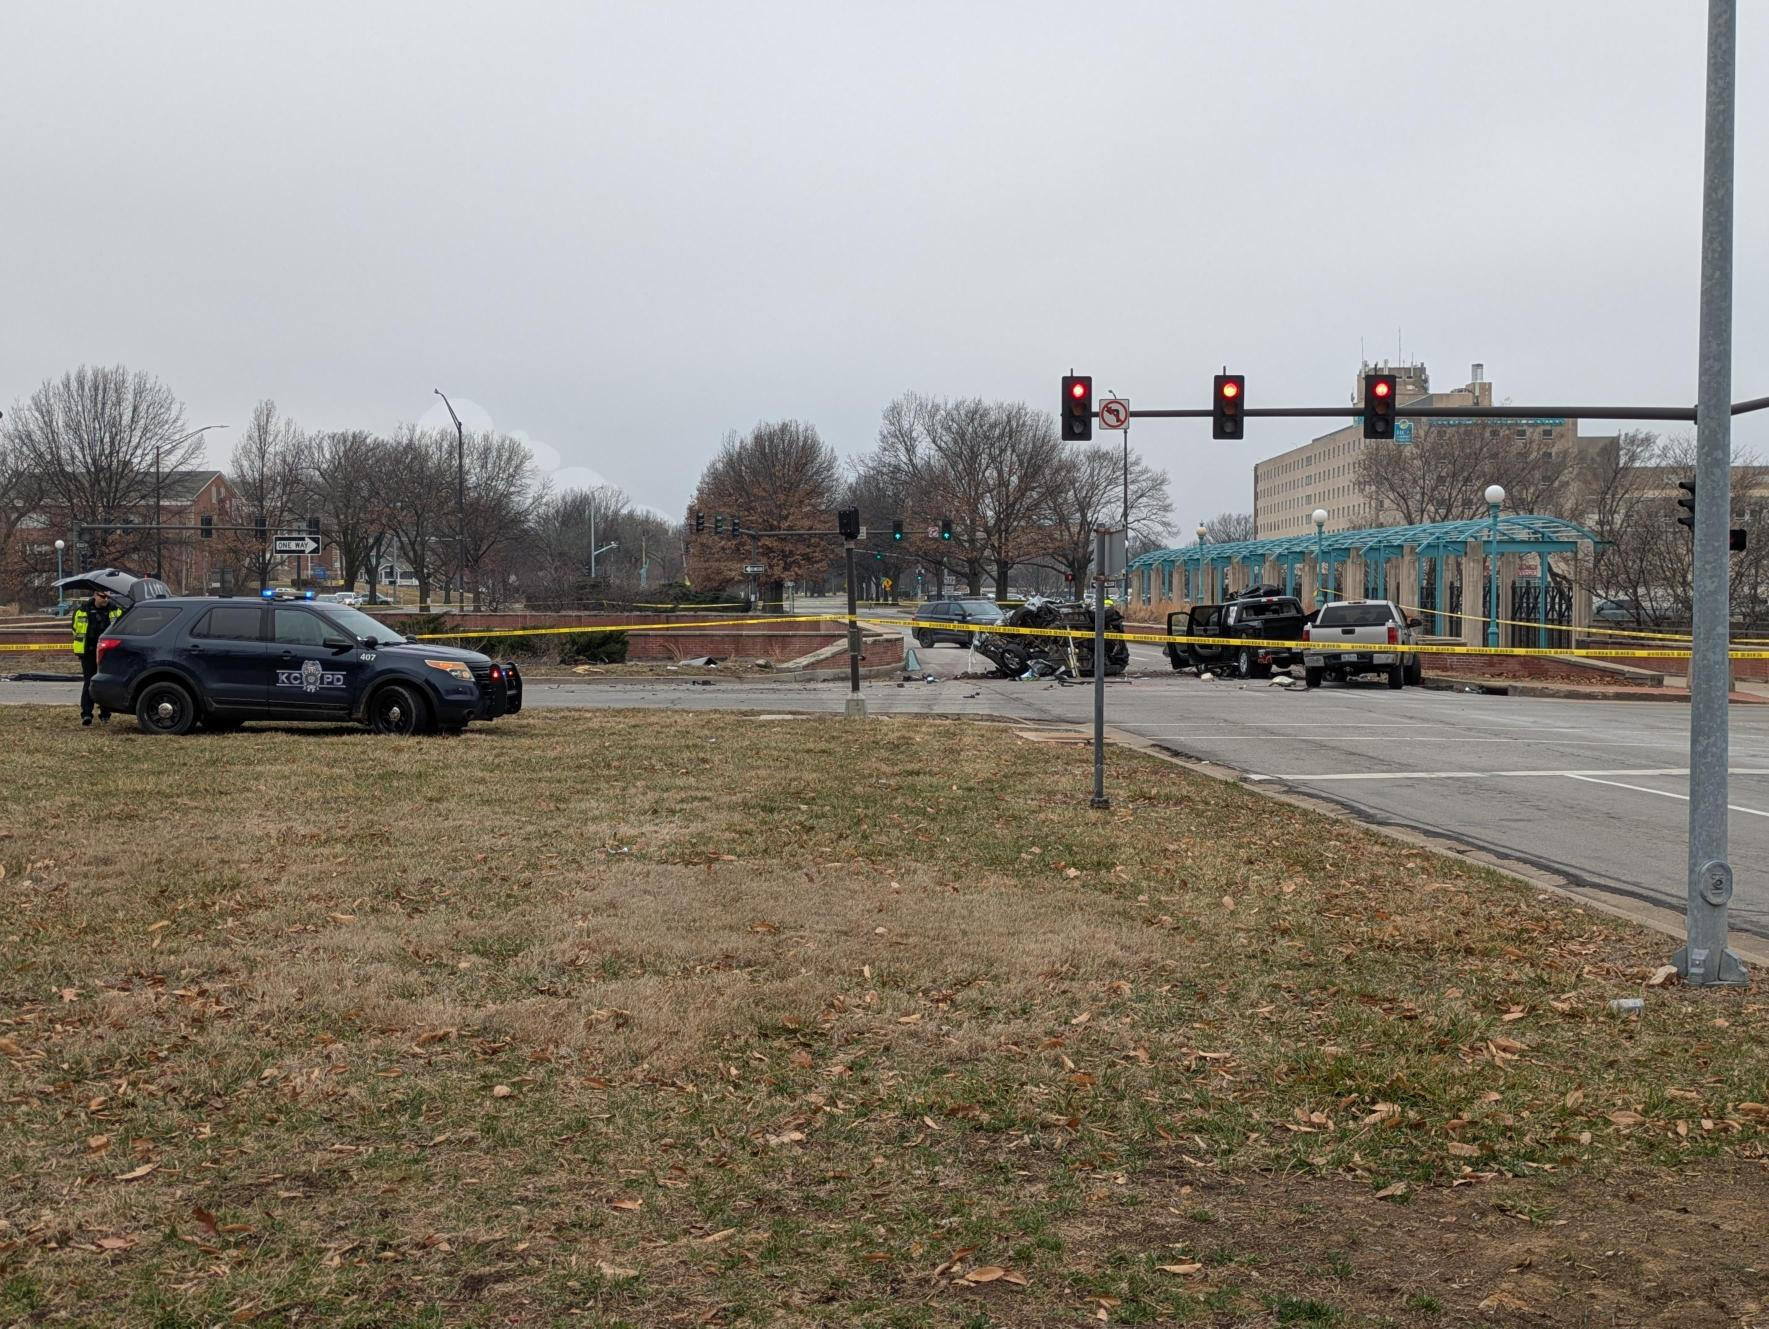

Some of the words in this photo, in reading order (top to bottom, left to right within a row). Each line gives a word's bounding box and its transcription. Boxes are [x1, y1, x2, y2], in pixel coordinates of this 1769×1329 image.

[278, 541, 292, 549] ONE
[295, 541, 309, 549] WAY
[360, 653, 376, 661] 407
[278, 672, 301, 684] KC
[323, 674, 344, 686] PD
